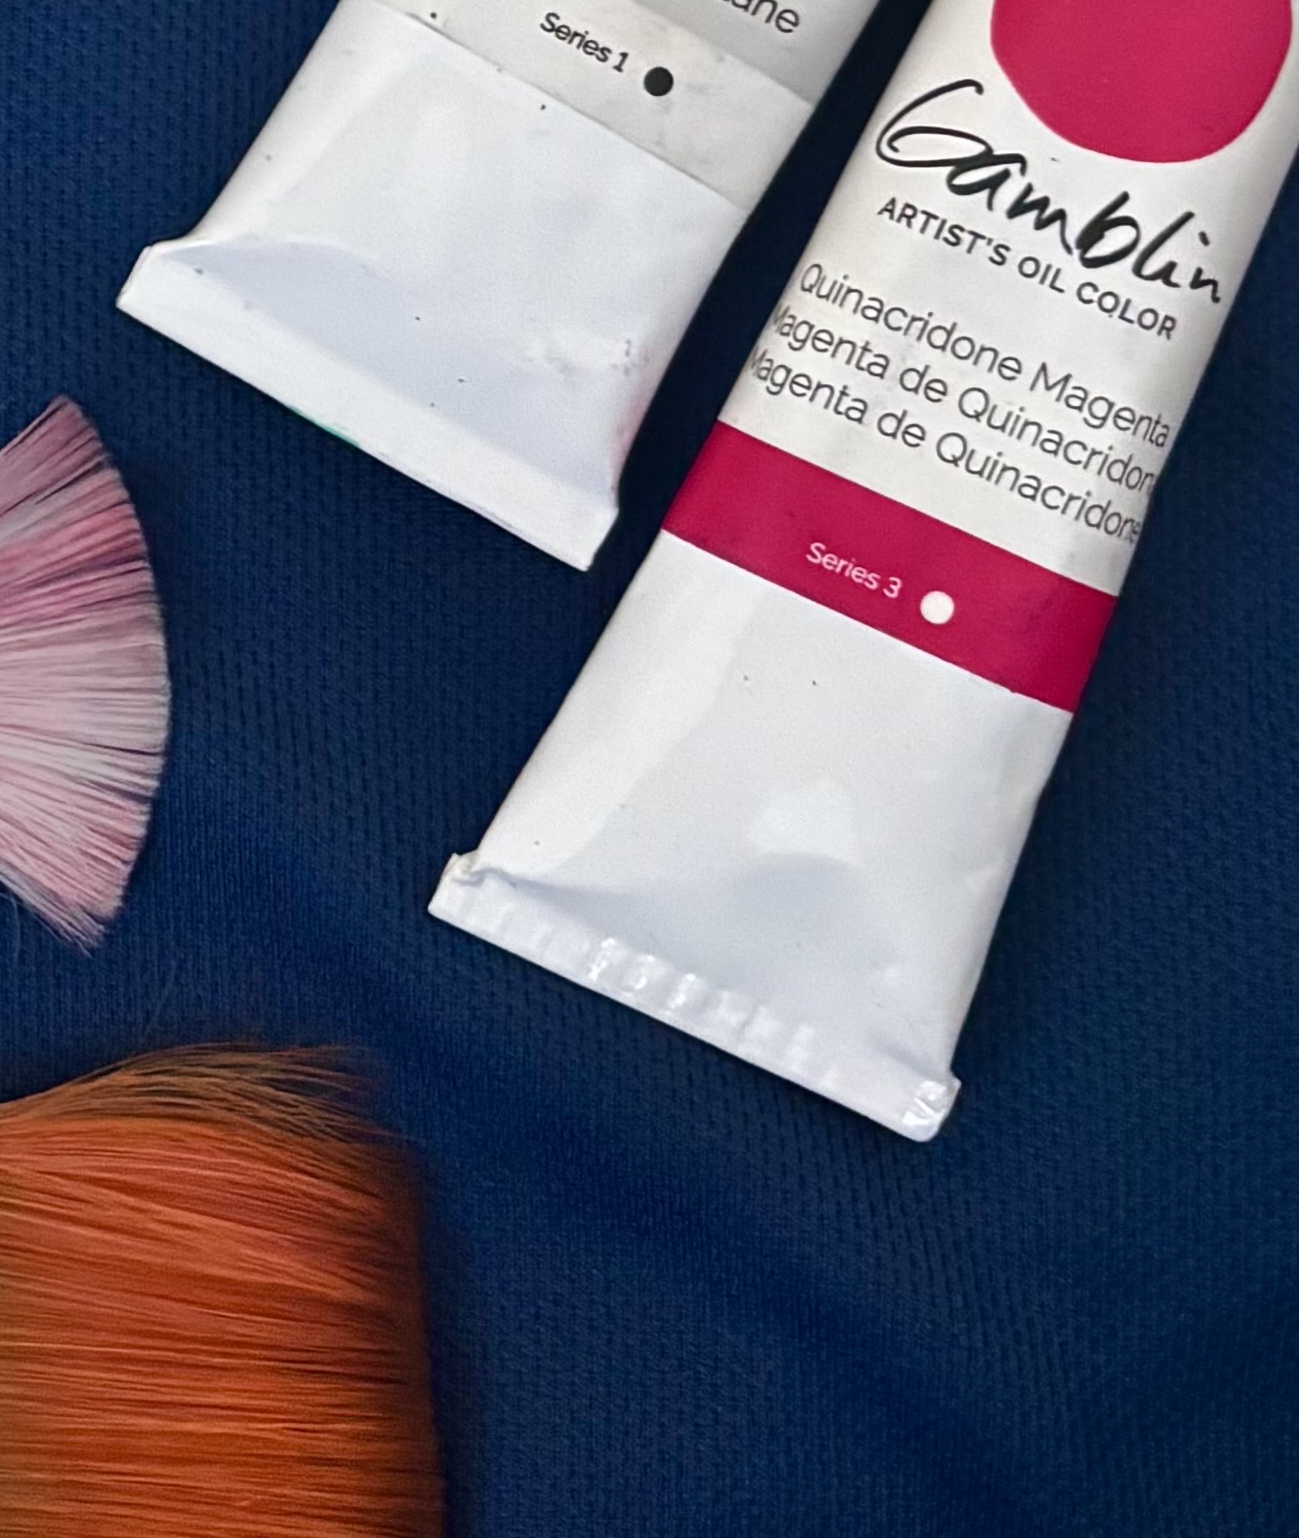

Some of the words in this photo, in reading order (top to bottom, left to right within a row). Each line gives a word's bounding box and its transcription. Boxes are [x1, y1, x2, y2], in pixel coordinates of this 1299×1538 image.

[539, 11, 612, 63] Series
[612, 51, 630, 73] 1
[875, 78, 1221, 305] Gamblin
[877, 197, 1011, 267] ARTIST'S
[1017, 255, 1066, 295] OIL
[1076, 281, 1178, 341] COLOR
[801, 263, 1023, 381] Quinacridone
[1029, 362, 1171, 448] Magenta
[899, 364, 949, 404] de
[877, 409, 926, 448] de
[805, 540, 882, 593] Series
[881, 575, 903, 600] 3
